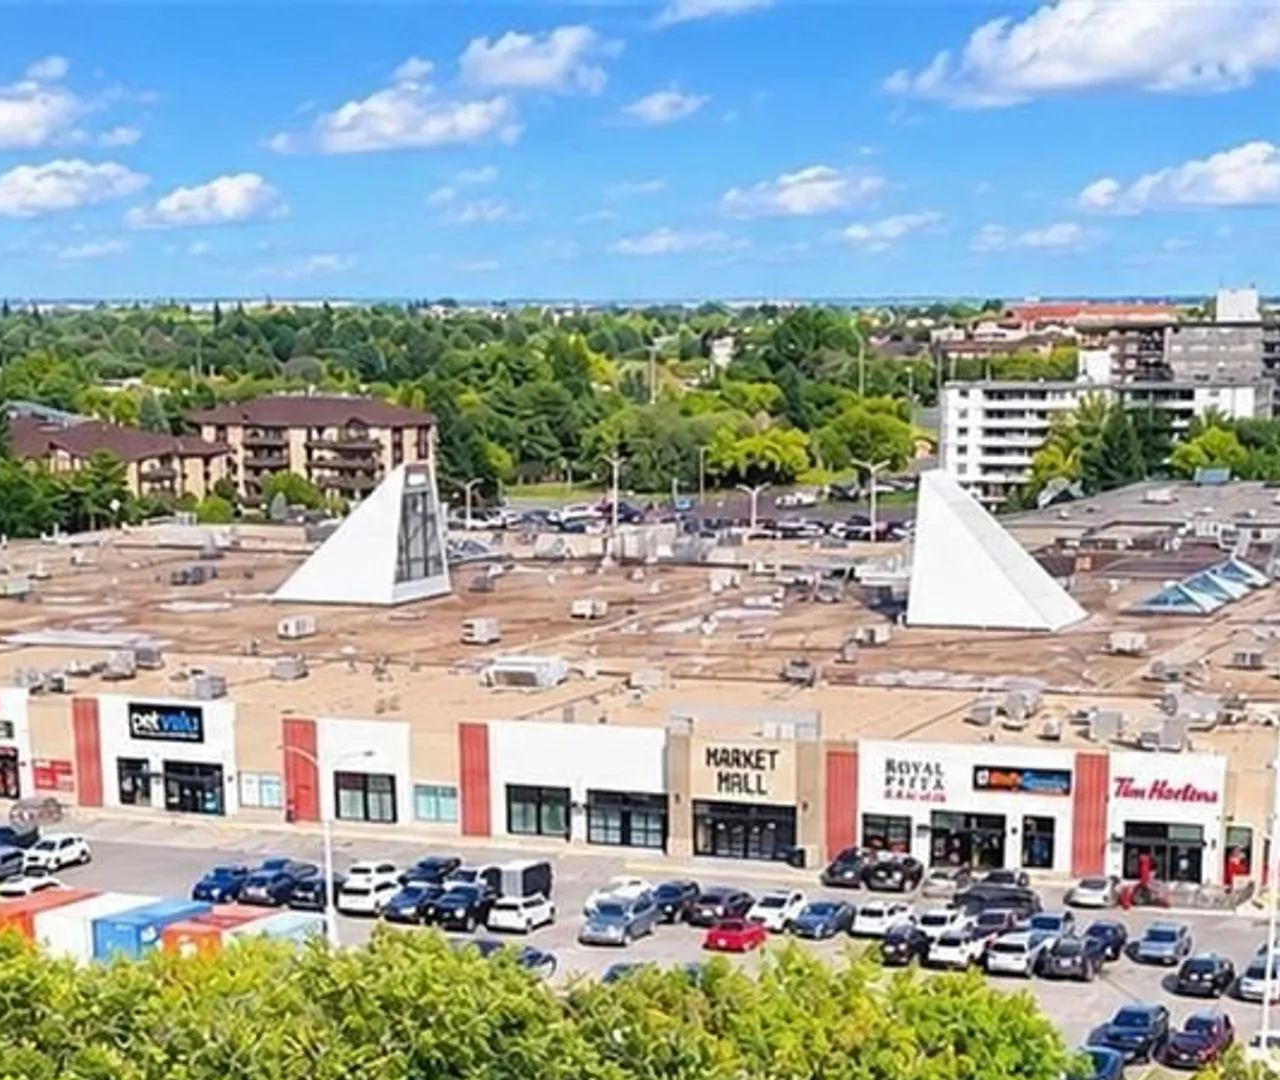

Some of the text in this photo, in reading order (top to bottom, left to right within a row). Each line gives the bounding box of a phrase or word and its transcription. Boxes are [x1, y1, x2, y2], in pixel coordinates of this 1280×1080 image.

[705, 747, 779, 771] MARKET
[885, 758, 944, 777] ROYAL
[717, 771, 767, 795] MALL
[1114, 777, 1218, 803] Tim Hortons
